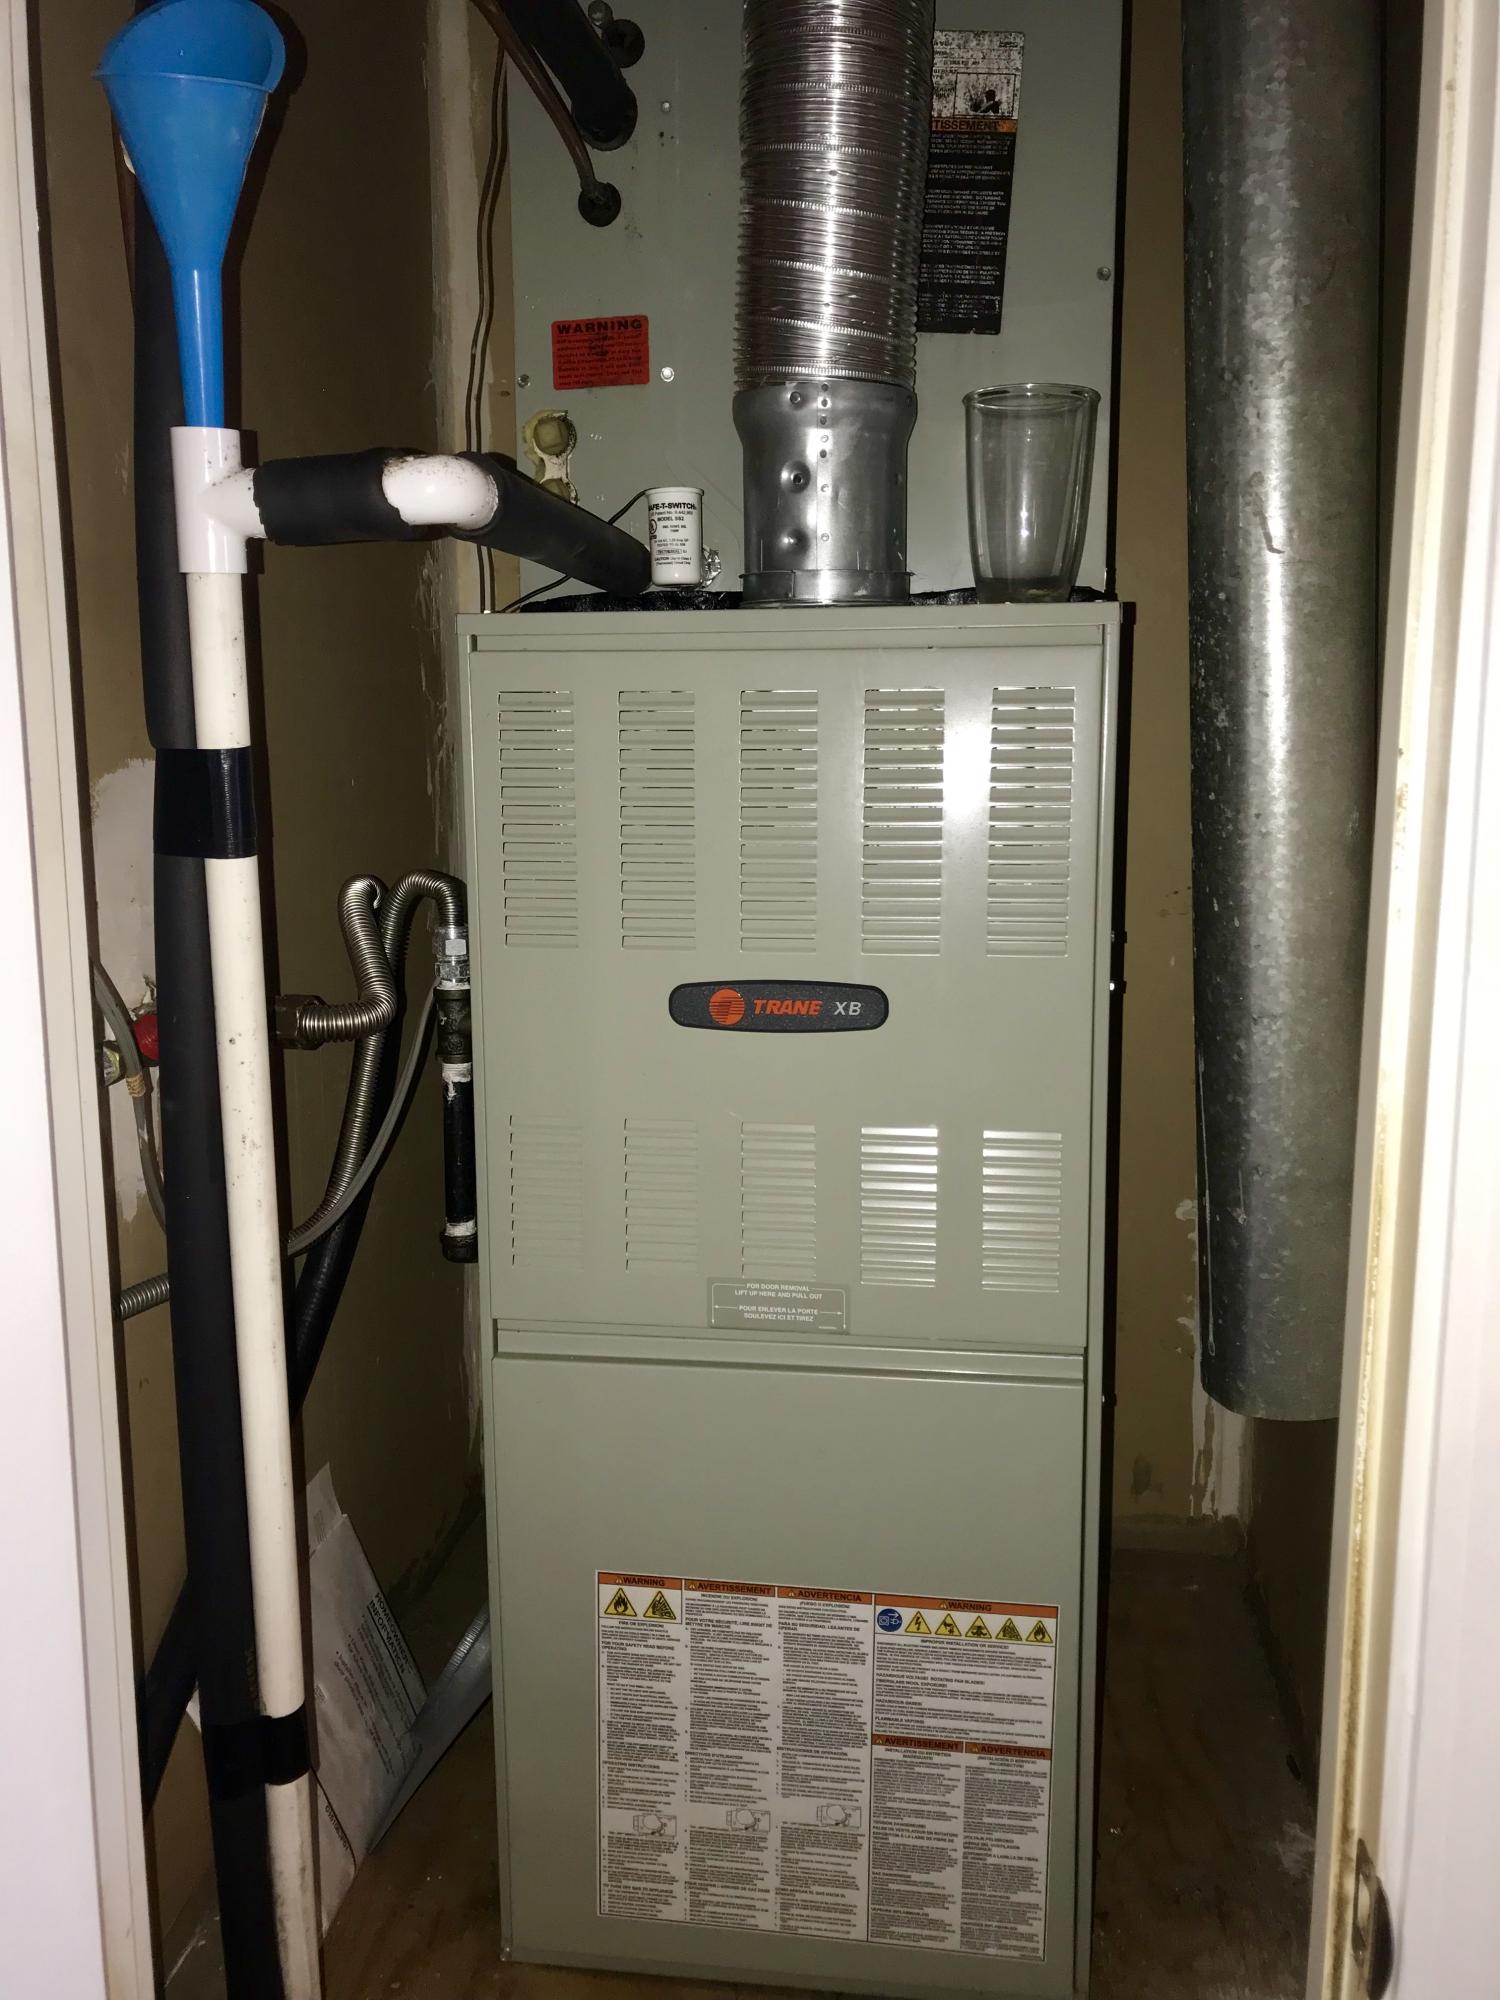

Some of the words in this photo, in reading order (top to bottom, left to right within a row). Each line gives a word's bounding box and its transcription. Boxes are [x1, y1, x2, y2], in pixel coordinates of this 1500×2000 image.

[934, 120, 999, 130] TISSEMENT
[556, 318, 642, 334] WARNING
[753, 999, 823, 1016] TRANE
[833, 1000, 862, 1016] XB
[623, 1577, 665, 1586] WARNING
[698, 1582, 771, 1595] AVERTISSEMENT
[798, 1590, 861, 1601] ADVERTENCIA
[948, 1602, 992, 1612] WARNING
[885, 1737, 958, 1750] AVERTISSEMENT
[980, 1745, 1045, 1757] ADVERTENCIA
